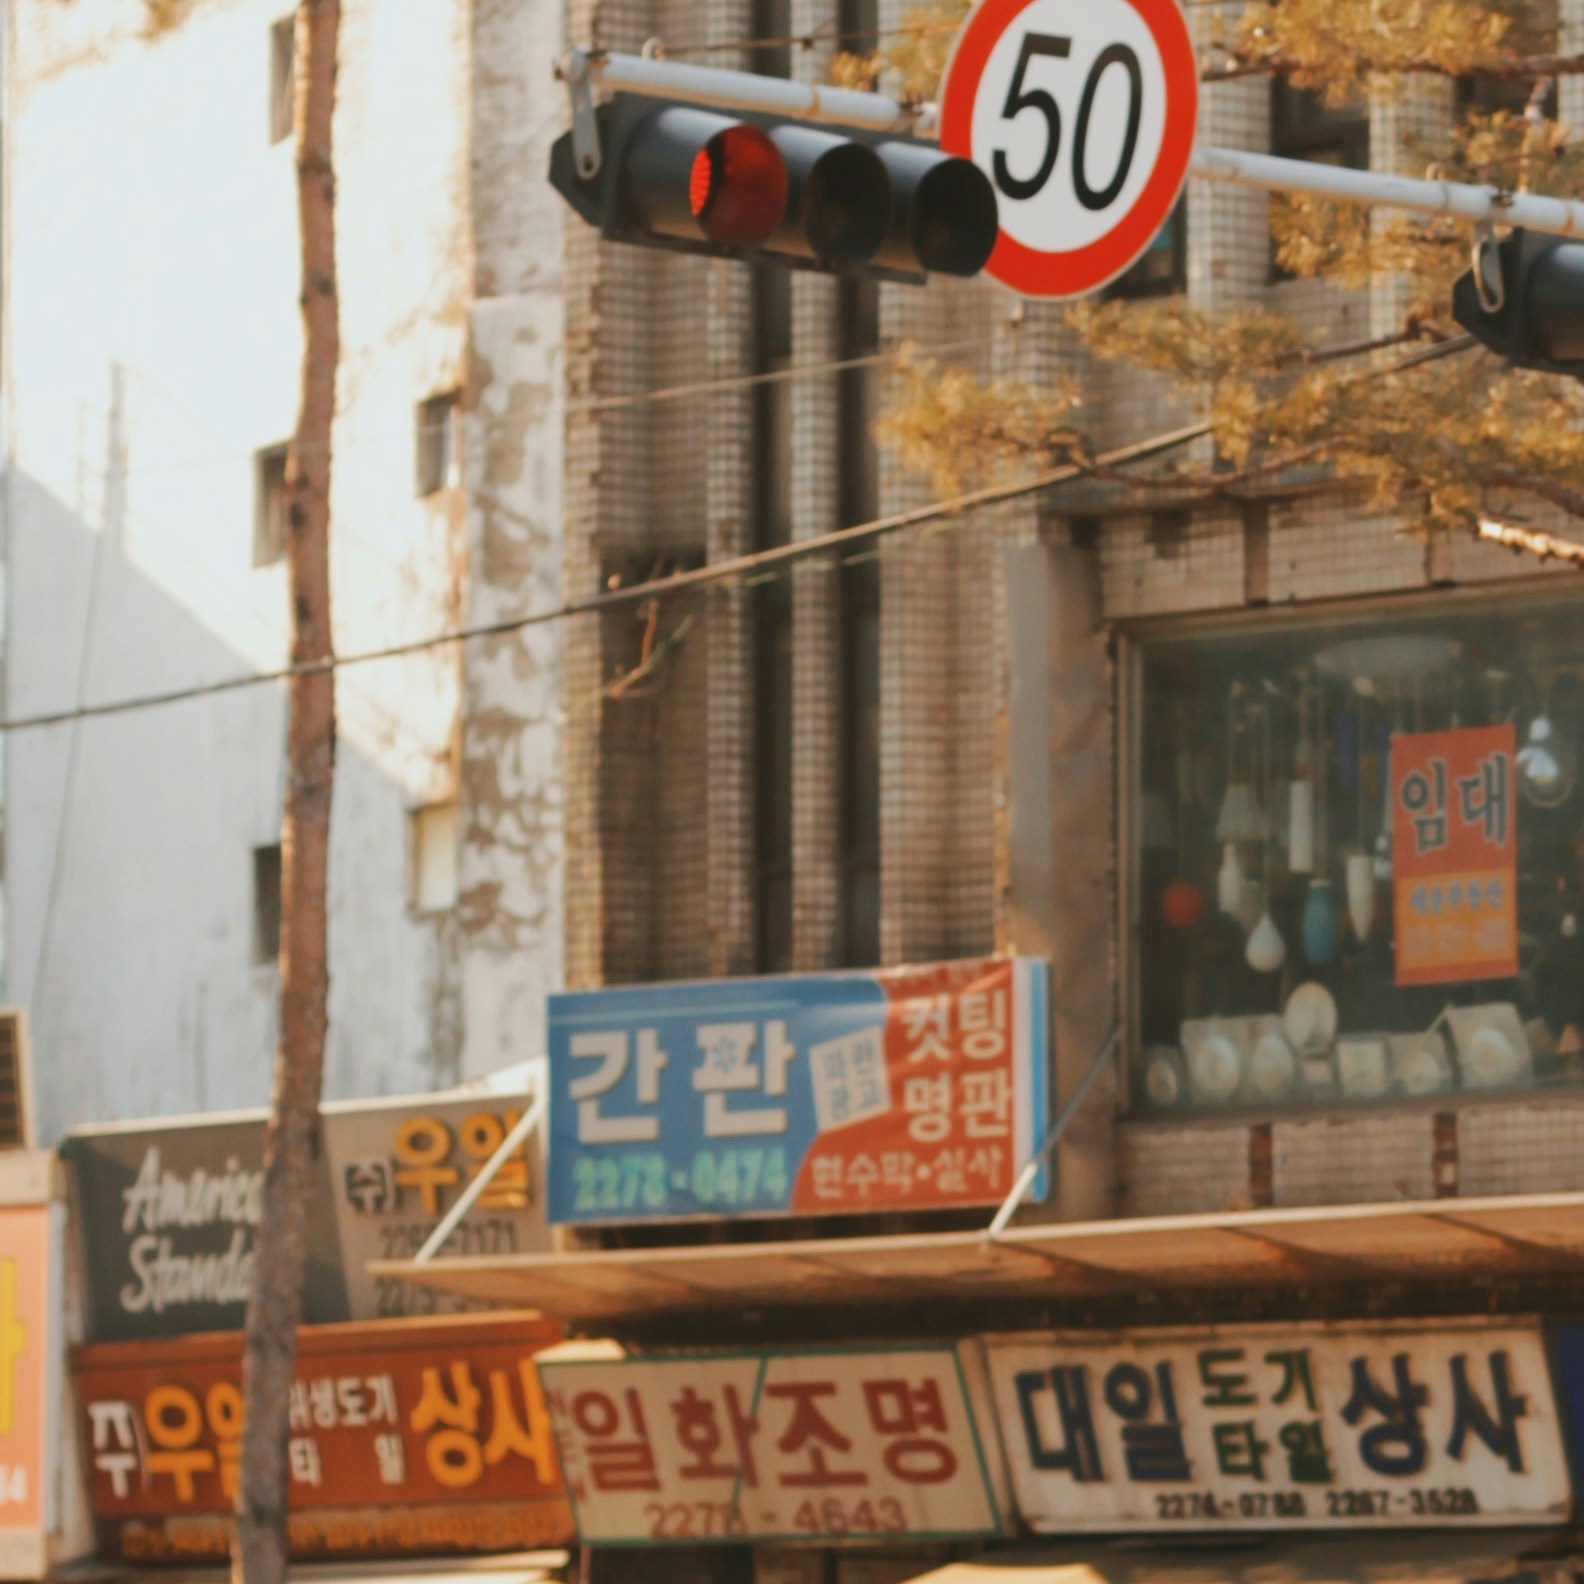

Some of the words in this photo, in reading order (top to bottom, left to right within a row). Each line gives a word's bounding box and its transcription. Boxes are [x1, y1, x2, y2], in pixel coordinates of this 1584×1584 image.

[993, 31, 1143, 212] 50
[1401, 751, 1507, 854] 임대
[902, 989, 1007, 1064] 컷팅
[568, 1018, 796, 1145] 간판
[904, 1069, 1012, 1143] 명판
[121, 1144, 267, 1234] Americ
[120, 1227, 257, 1313] Stand
[411, 1360, 554, 1487] 상사
[1015, 1359, 1195, 1483] 대일
[1341, 1349, 1528, 1476] 상사
[1198, 1346, 1317, 1411] 도기
[571, 1377, 958, 1493] 일화조명
[1212, 1419, 1333, 1484] 타일
